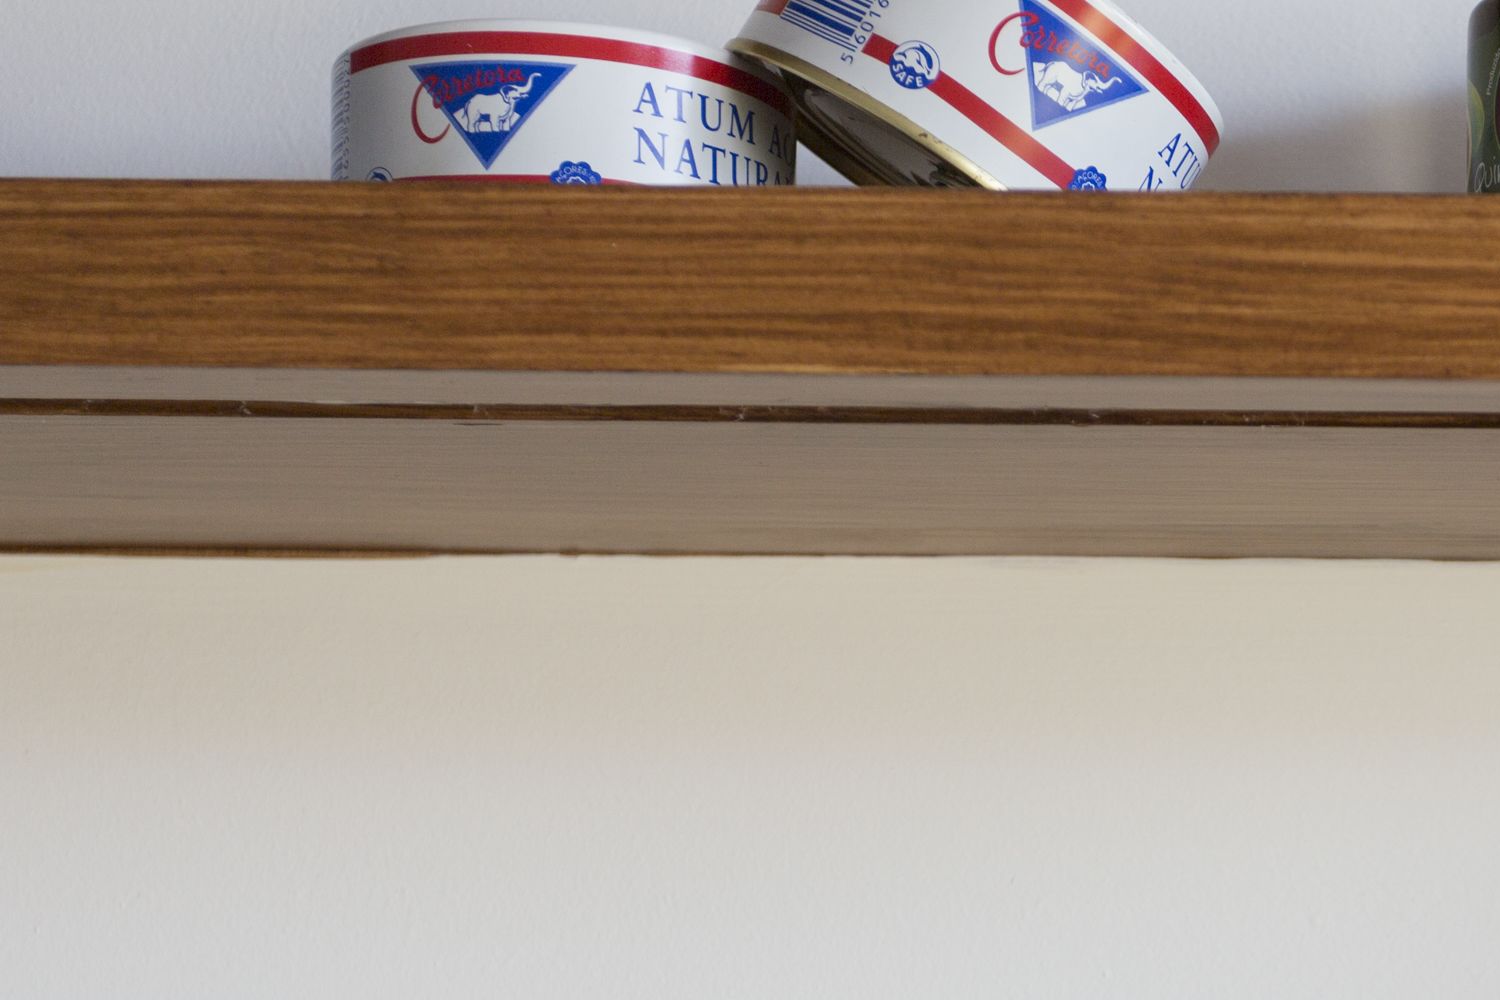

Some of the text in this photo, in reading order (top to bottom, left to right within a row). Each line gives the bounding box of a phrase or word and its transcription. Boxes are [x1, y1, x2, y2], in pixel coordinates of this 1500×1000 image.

[892, 63, 923, 88] SAFE
[988, 11, 1111, 79] Corretora
[411, 67, 525, 143] Corretora
[632, 81, 756, 145] ATUM
